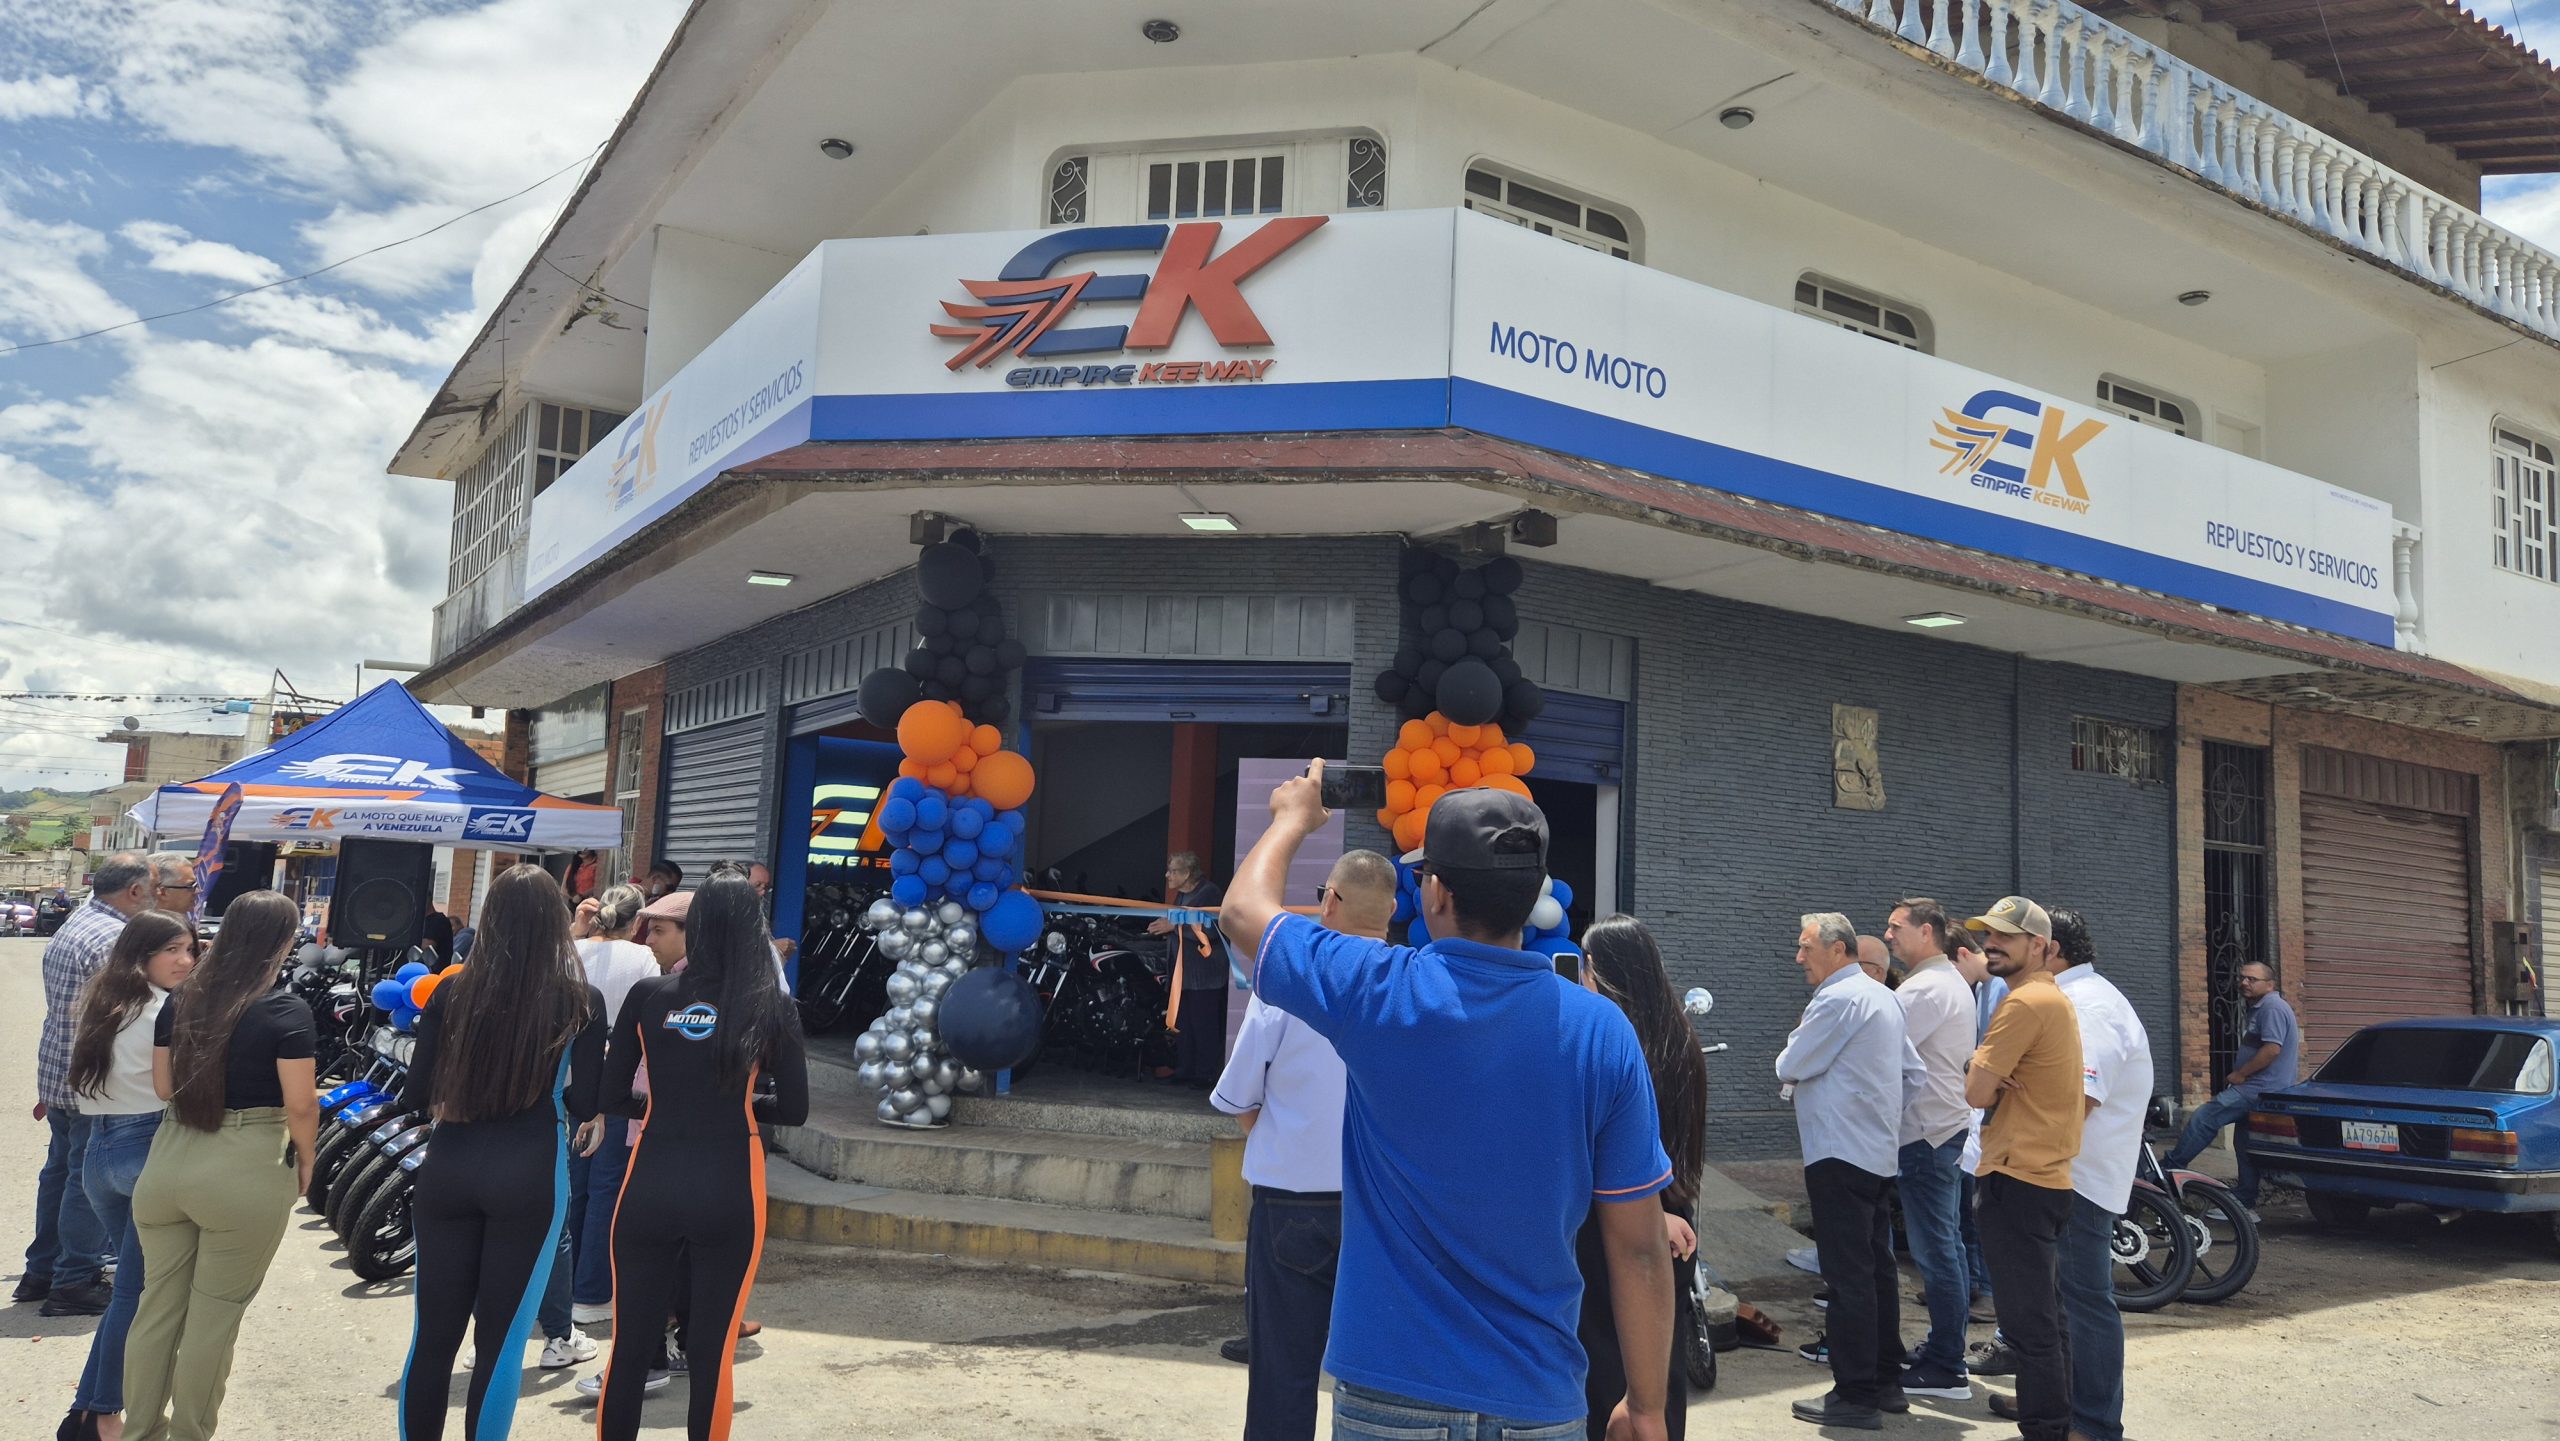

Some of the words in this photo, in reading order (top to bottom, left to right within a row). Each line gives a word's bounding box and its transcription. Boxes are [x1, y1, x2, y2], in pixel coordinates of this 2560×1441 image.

[985, 215, 1330, 358] EK
[1004, 364, 1137, 388] EMPIRE
[1138, 359, 1277, 382] KEEWAY
[1490, 321, 1578, 374] MOTO
[1585, 349, 1667, 399] MOTO
[688, 407, 740, 465] REPUESTOS
[741, 401, 748, 429] Y
[748, 359, 803, 424] SERVICIOS
[1955, 390, 2109, 501] EK
[1971, 474, 2033, 499] EMPIRE
[2033, 490, 2091, 515] KEEWAY
[2206, 520, 2293, 566] REPUESTOS
[2295, 546, 2306, 569] Y
[2308, 550, 2379, 590] SERVICIOS
[298, 753, 479, 791] EK
[343, 812, 357, 820] LA
[360, 812, 396, 820] MOTO
[398, 813, 423, 822] QUE
[424, 814, 465, 824] MUEVE
[362, 823, 373, 831] A
[375, 823, 443, 833] VENEZUELA
[667, 1013, 698, 1024] MOTO
